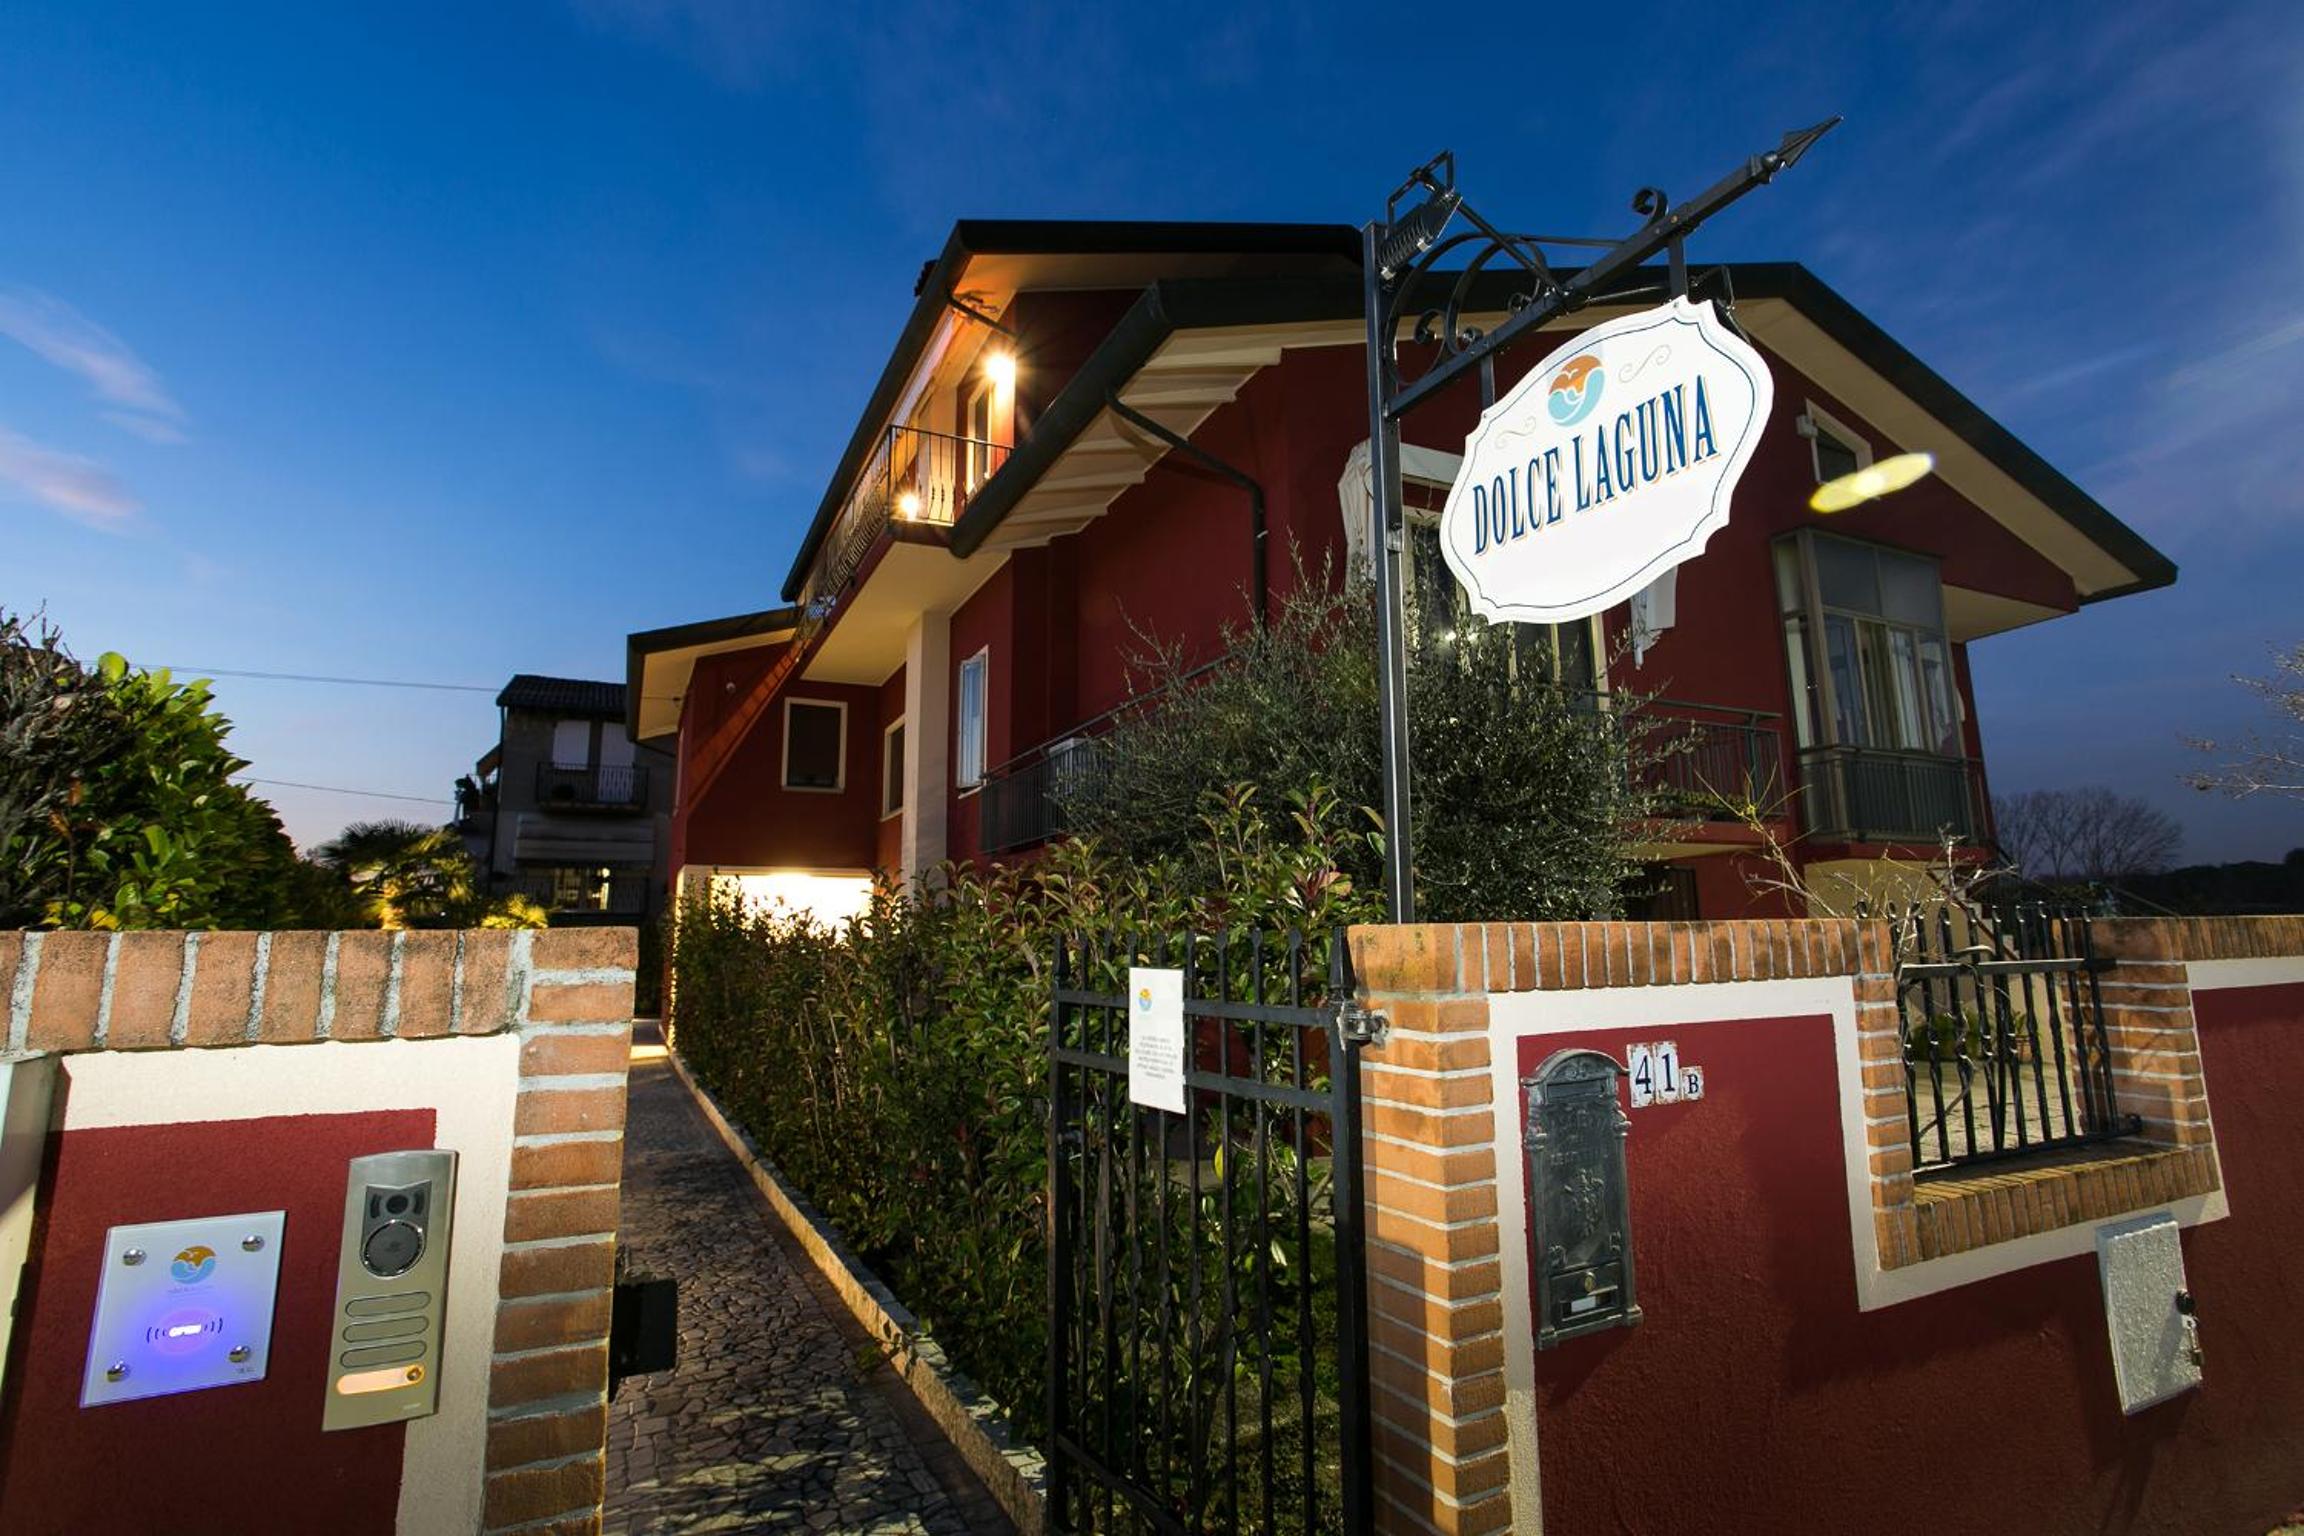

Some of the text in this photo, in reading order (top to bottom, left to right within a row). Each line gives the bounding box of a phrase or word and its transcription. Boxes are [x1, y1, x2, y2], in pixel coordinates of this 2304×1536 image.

[1472, 375, 1720, 556] DOLCE LAGUNA
[1635, 1053, 1675, 1094] 41
